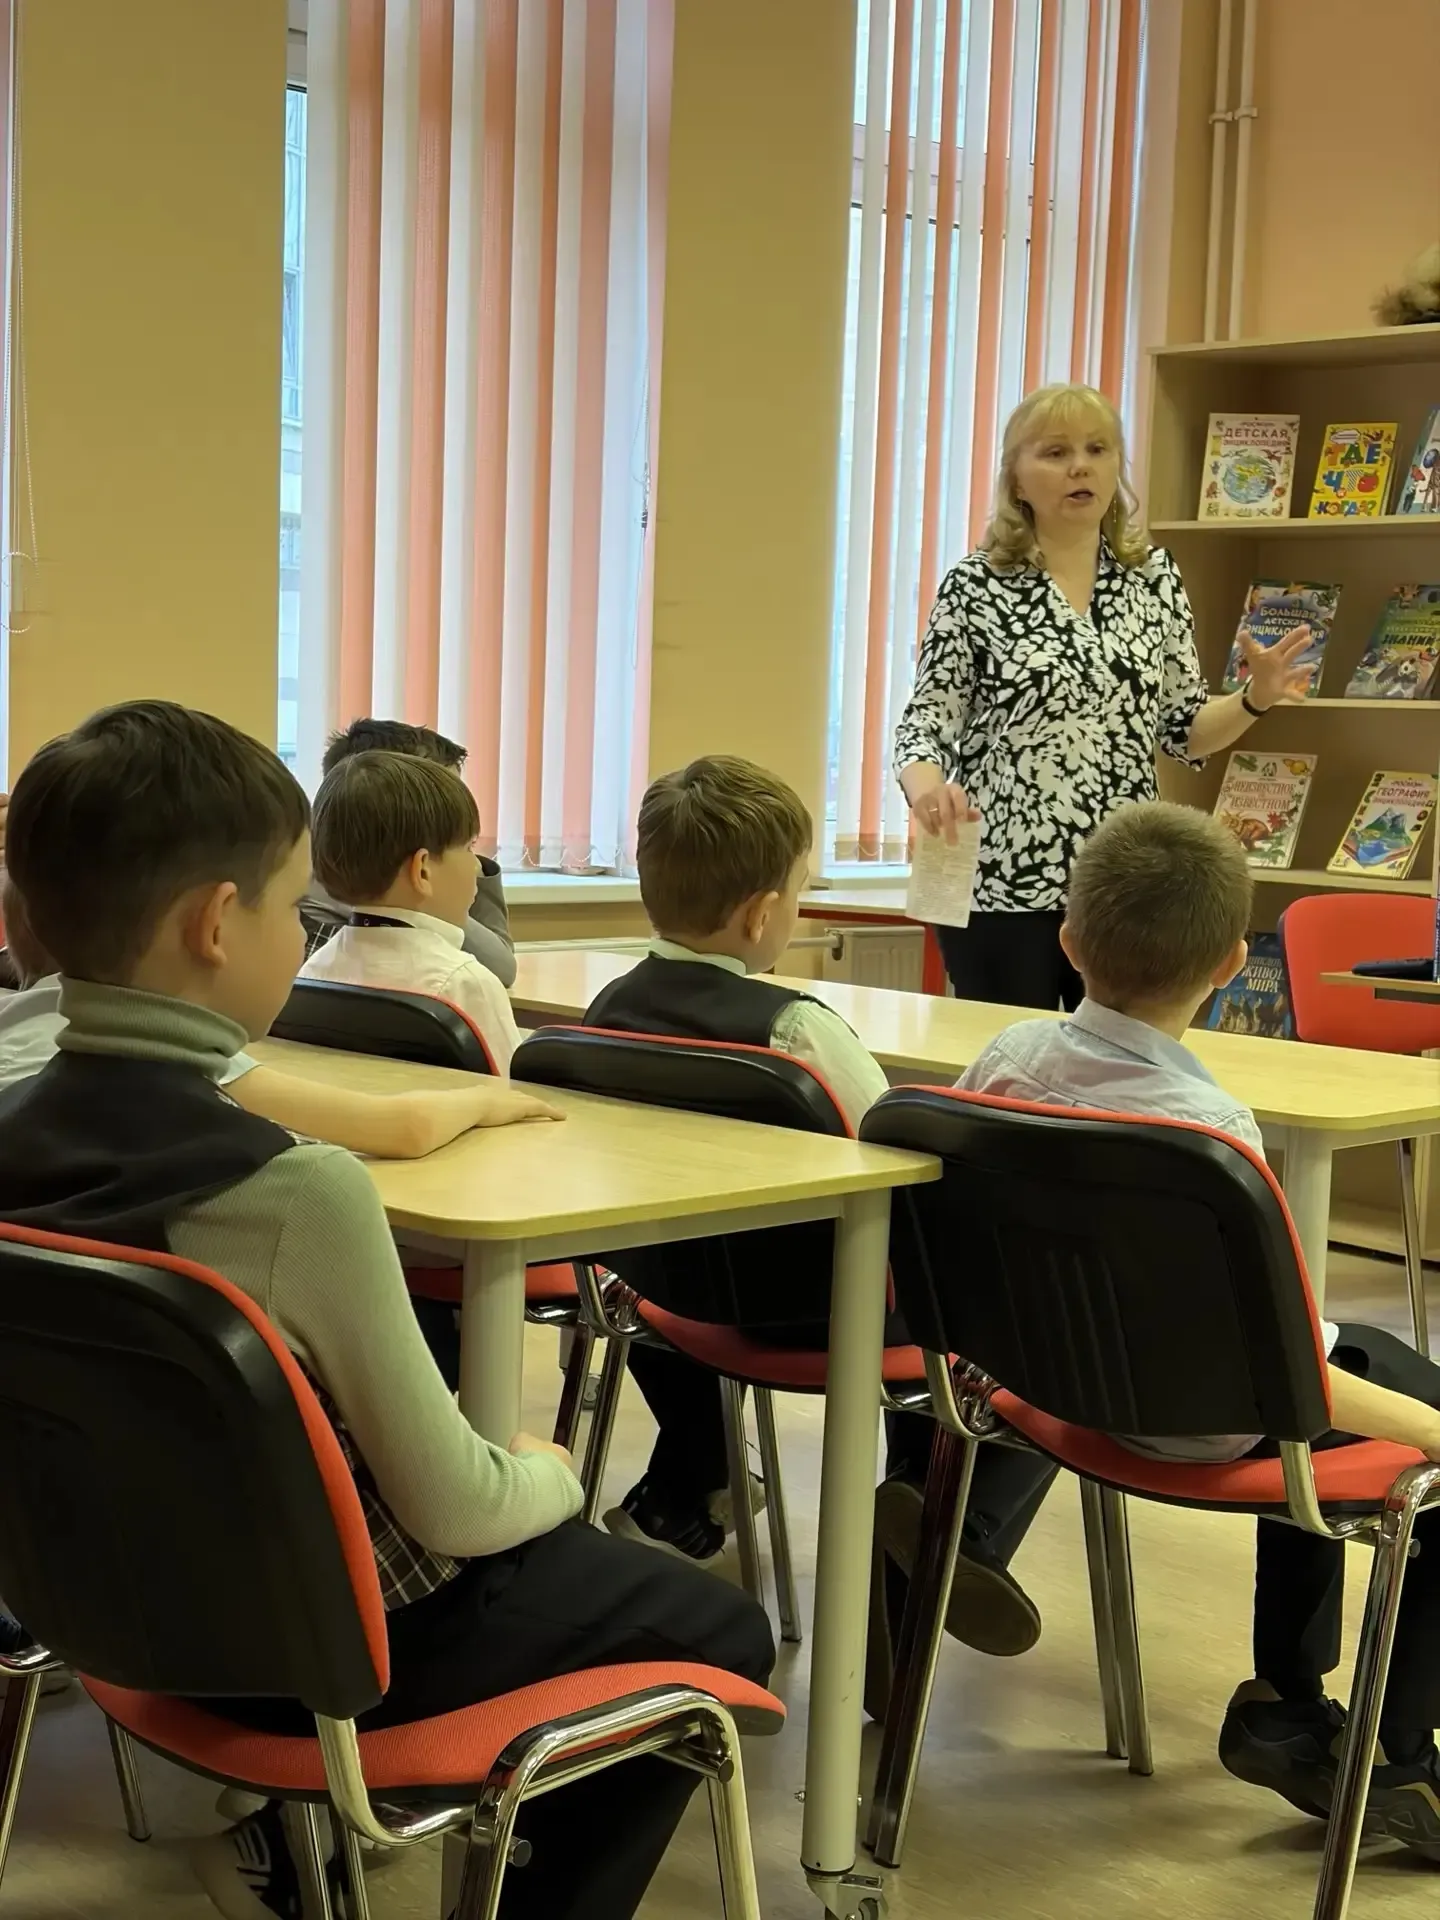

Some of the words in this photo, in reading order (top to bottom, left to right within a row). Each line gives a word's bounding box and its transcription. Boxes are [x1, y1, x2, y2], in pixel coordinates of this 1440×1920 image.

[1223, 427, 1289, 439] ДЕТСКАЯ
[1325, 442, 1382, 467] ГДЕ
[1376, 787, 1430, 798] ГЕОГРАФИЯ
[1245, 978, 1279, 993] МИРА
